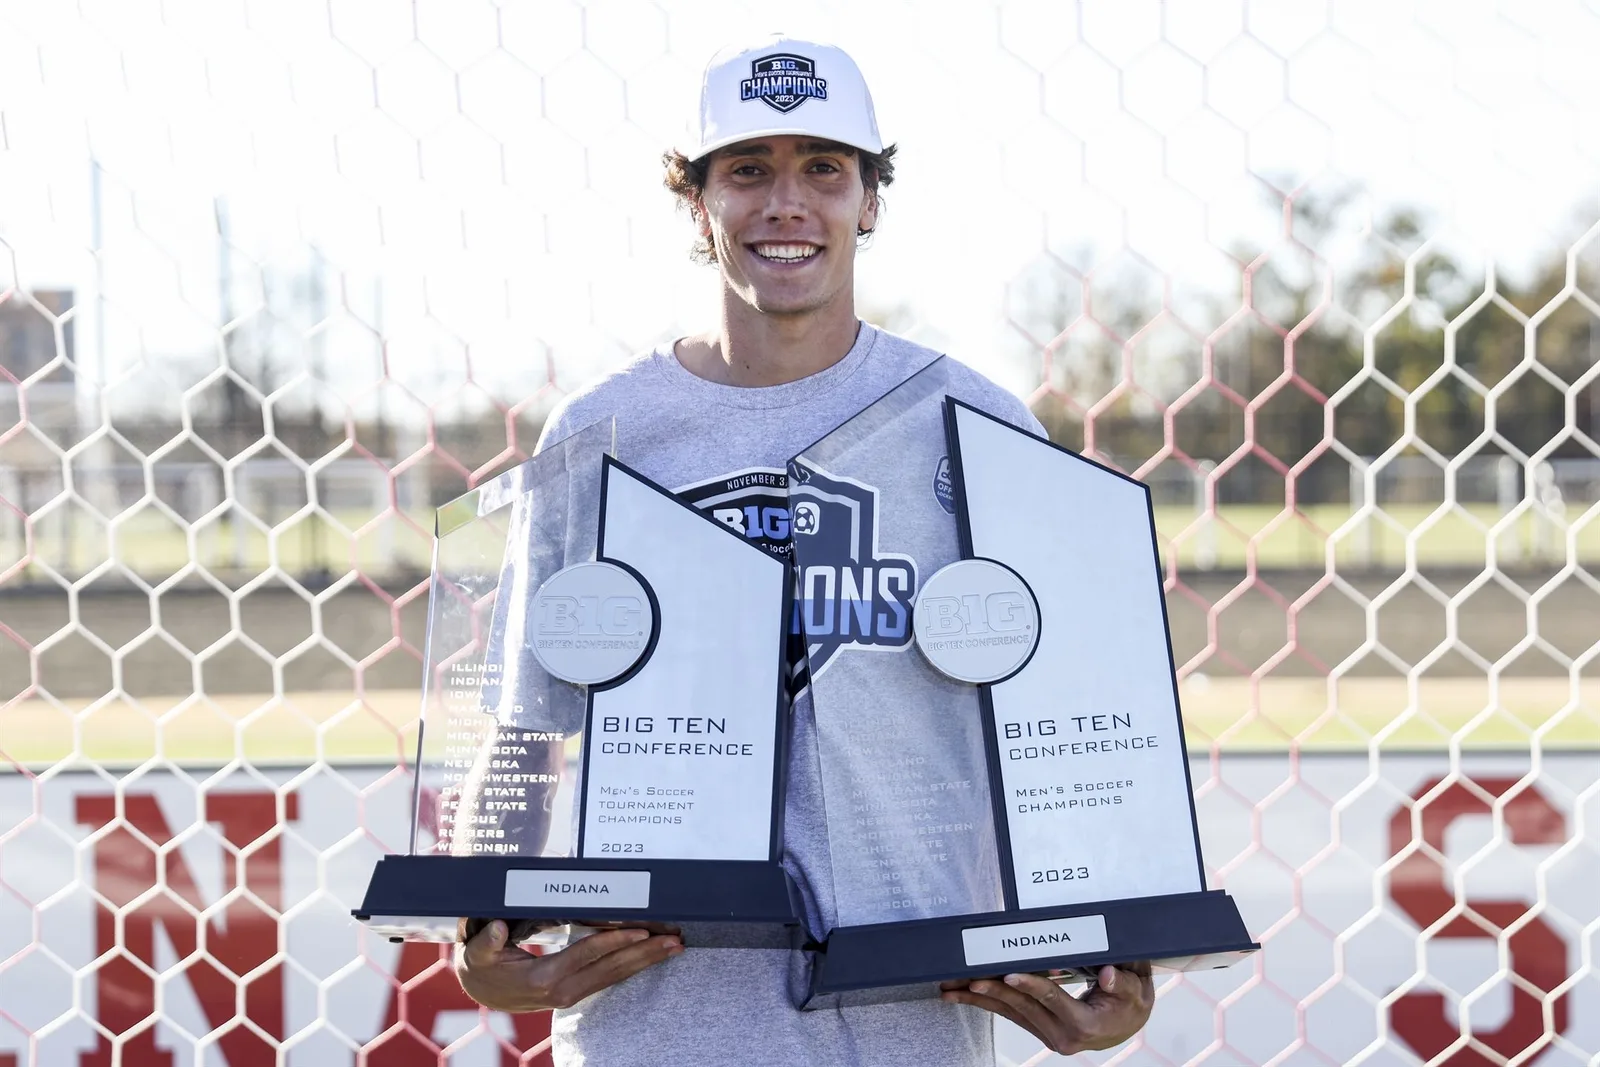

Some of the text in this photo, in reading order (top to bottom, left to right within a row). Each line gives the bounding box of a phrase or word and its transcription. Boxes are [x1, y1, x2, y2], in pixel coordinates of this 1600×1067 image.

[741, 76, 827, 99] CHAMPIONS
[727, 474, 776, 491] NOVEMBER
[538, 639, 640, 650] BIG TEN CONFERENCE
[927, 634, 1031, 652] BIG TEN CONFERENCE
[451, 663, 504, 673] ILLINOI
[449, 690, 484, 699] IOWA
[603, 717, 727, 734] BIG TEN
[1004, 712, 1132, 740] BIG TEN
[522, 732, 565, 742] STATE
[445, 746, 529, 755] MINNSOTA
[602, 742, 754, 756] CONFERENCE
[1009, 735, 1159, 761] CONFERENCE
[929, 780, 972, 792] STATE
[484, 787, 527, 797] STATE
[485, 801, 528, 811] STATE
[598, 801, 695, 811] TOURNAMENT
[1018, 795, 1123, 814] CHAMPIONS
[439, 815, 499, 824] PUDUE
[598, 815, 683, 825] CHAMPIONS
[600, 843, 645, 853] 2023
[1031, 866, 1090, 884] 2023
[544, 883, 610, 894] INDIANA
[1001, 932, 1072, 949] INDIANA
